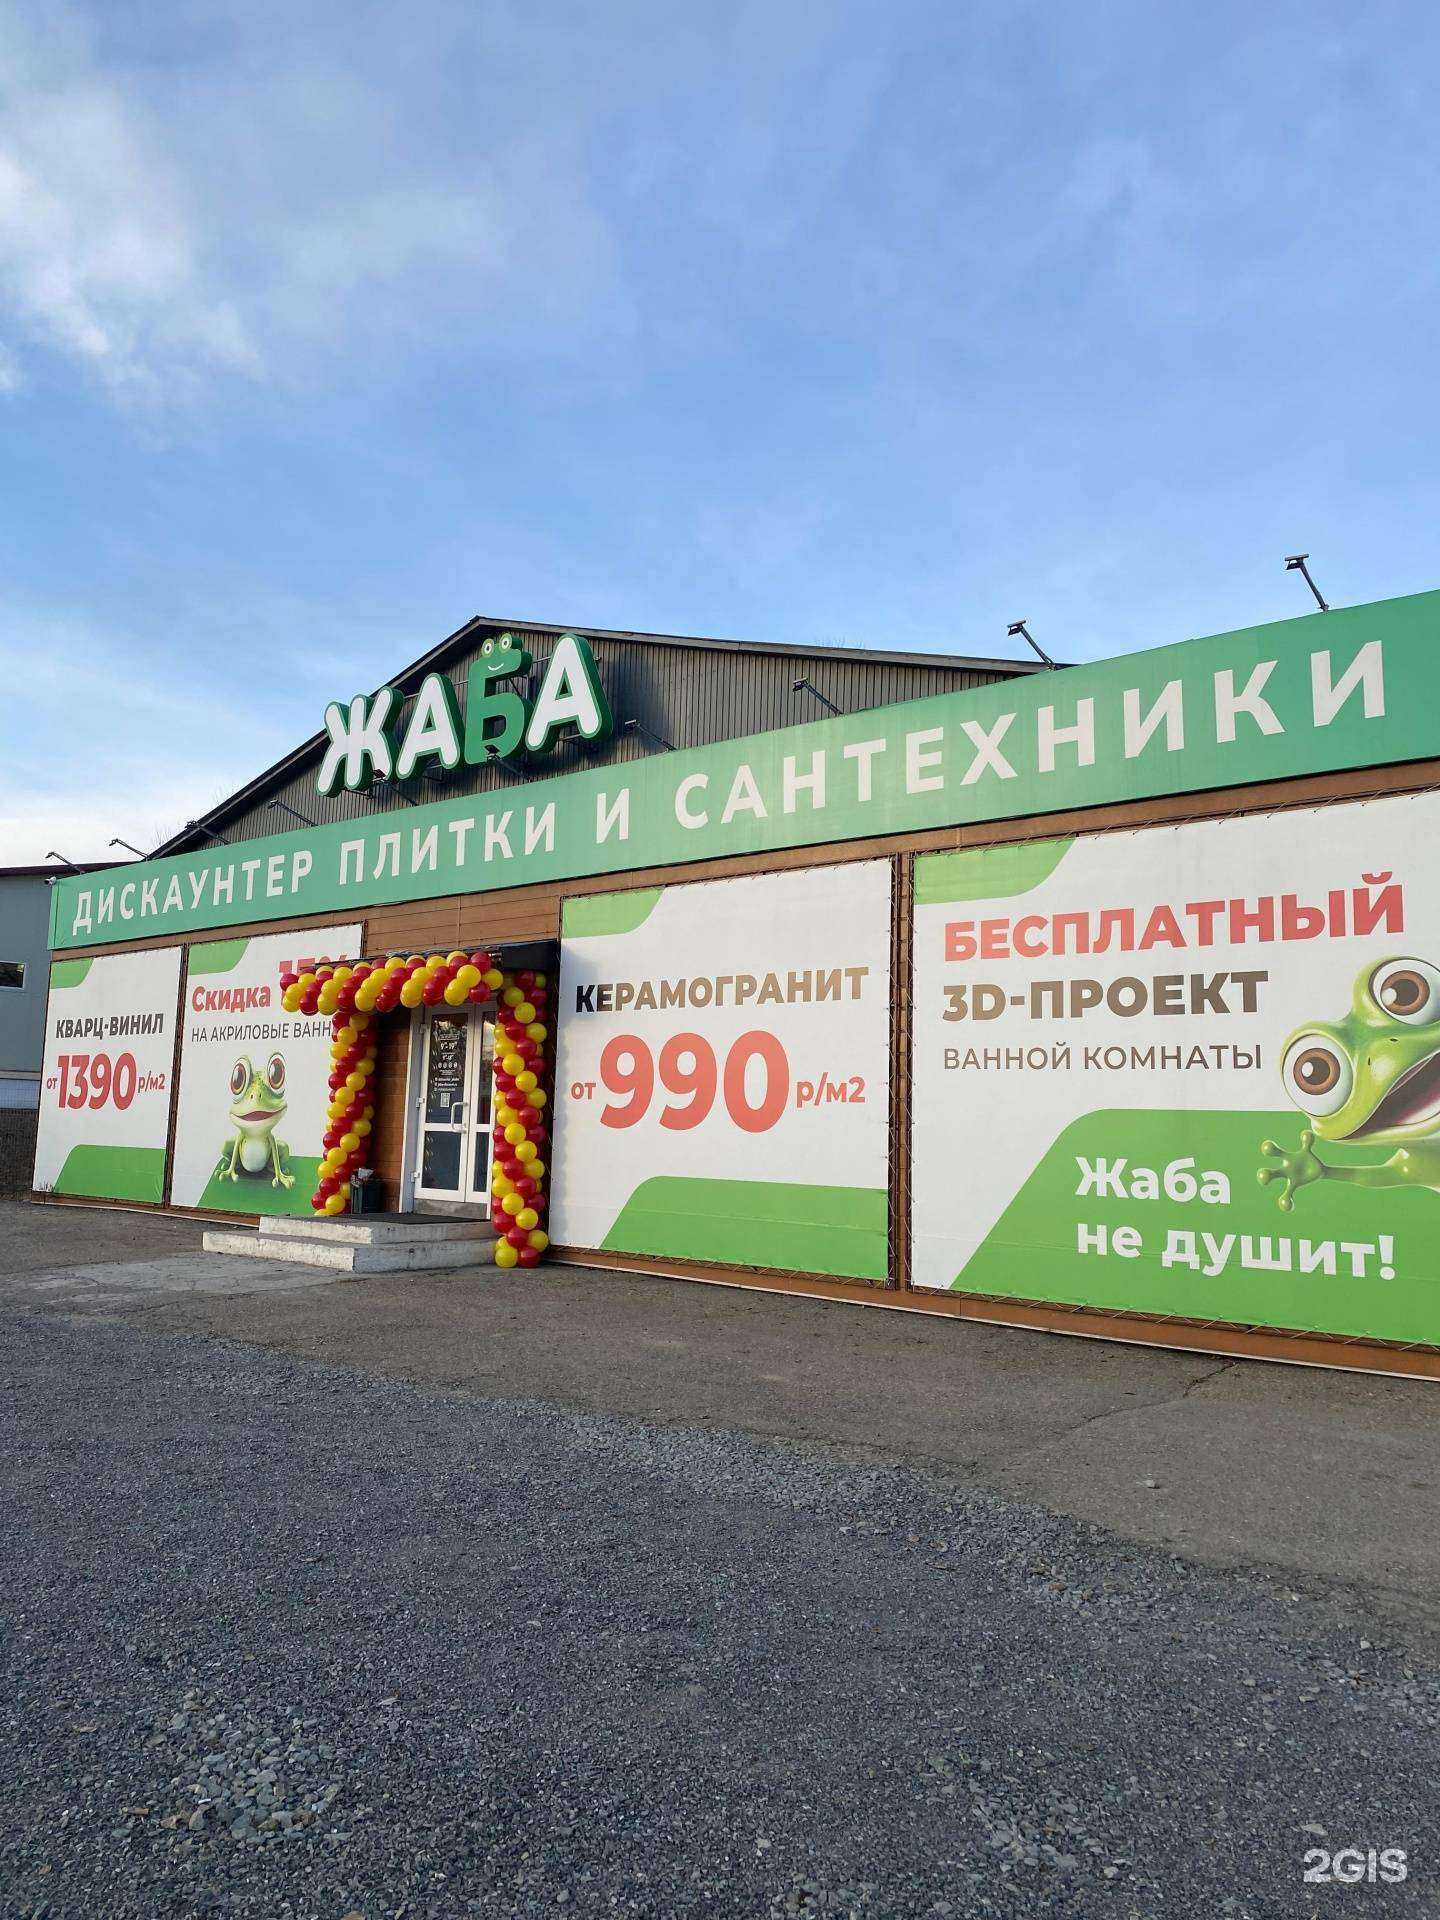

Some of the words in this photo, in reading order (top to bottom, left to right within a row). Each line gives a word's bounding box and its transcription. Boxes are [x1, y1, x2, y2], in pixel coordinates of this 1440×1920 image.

[315, 633, 612, 797] ЖАБА
[72, 850, 313, 936] ДИСКАУНТЕР
[339, 803, 556, 885] ПЛИТКИ
[596, 788, 630, 844] И
[674, 640, 1386, 830] САНТЕХНИКИ
[944, 871, 1405, 962] БЕСПЛАТНЫЙ
[191, 986, 271, 1013] Скидка
[575, 966, 870, 1013] КЕРАМОГРАНИТ
[942, 970, 1269, 1023] 3D-ПРОЕКТ
[55, 1013, 164, 1039] КВАРЦ-ВИНИЛ
[191, 1027, 207, 1042] НА
[210, 1023, 290, 1042] АКРИЛОВЫЕ
[293, 1020, 333, 1038] ВАНН
[46, 1078, 58, 1089] от
[57, 1052, 137, 1110] 1390
[137, 1072, 166, 1094] р/м2
[571, 1082, 596, 1100] от
[599, 1030, 790, 1133] 990
[796, 1072, 866, 1108] р/м2
[943, 1042, 1072, 1070] ВАННОЙ
[1083, 1045, 1262, 1070] КОМНАТЫ
[1075, 1156, 1231, 1204] Жаба
[1077, 1223, 1143, 1258] не
[1161, 1229, 1396, 1281] душит!
